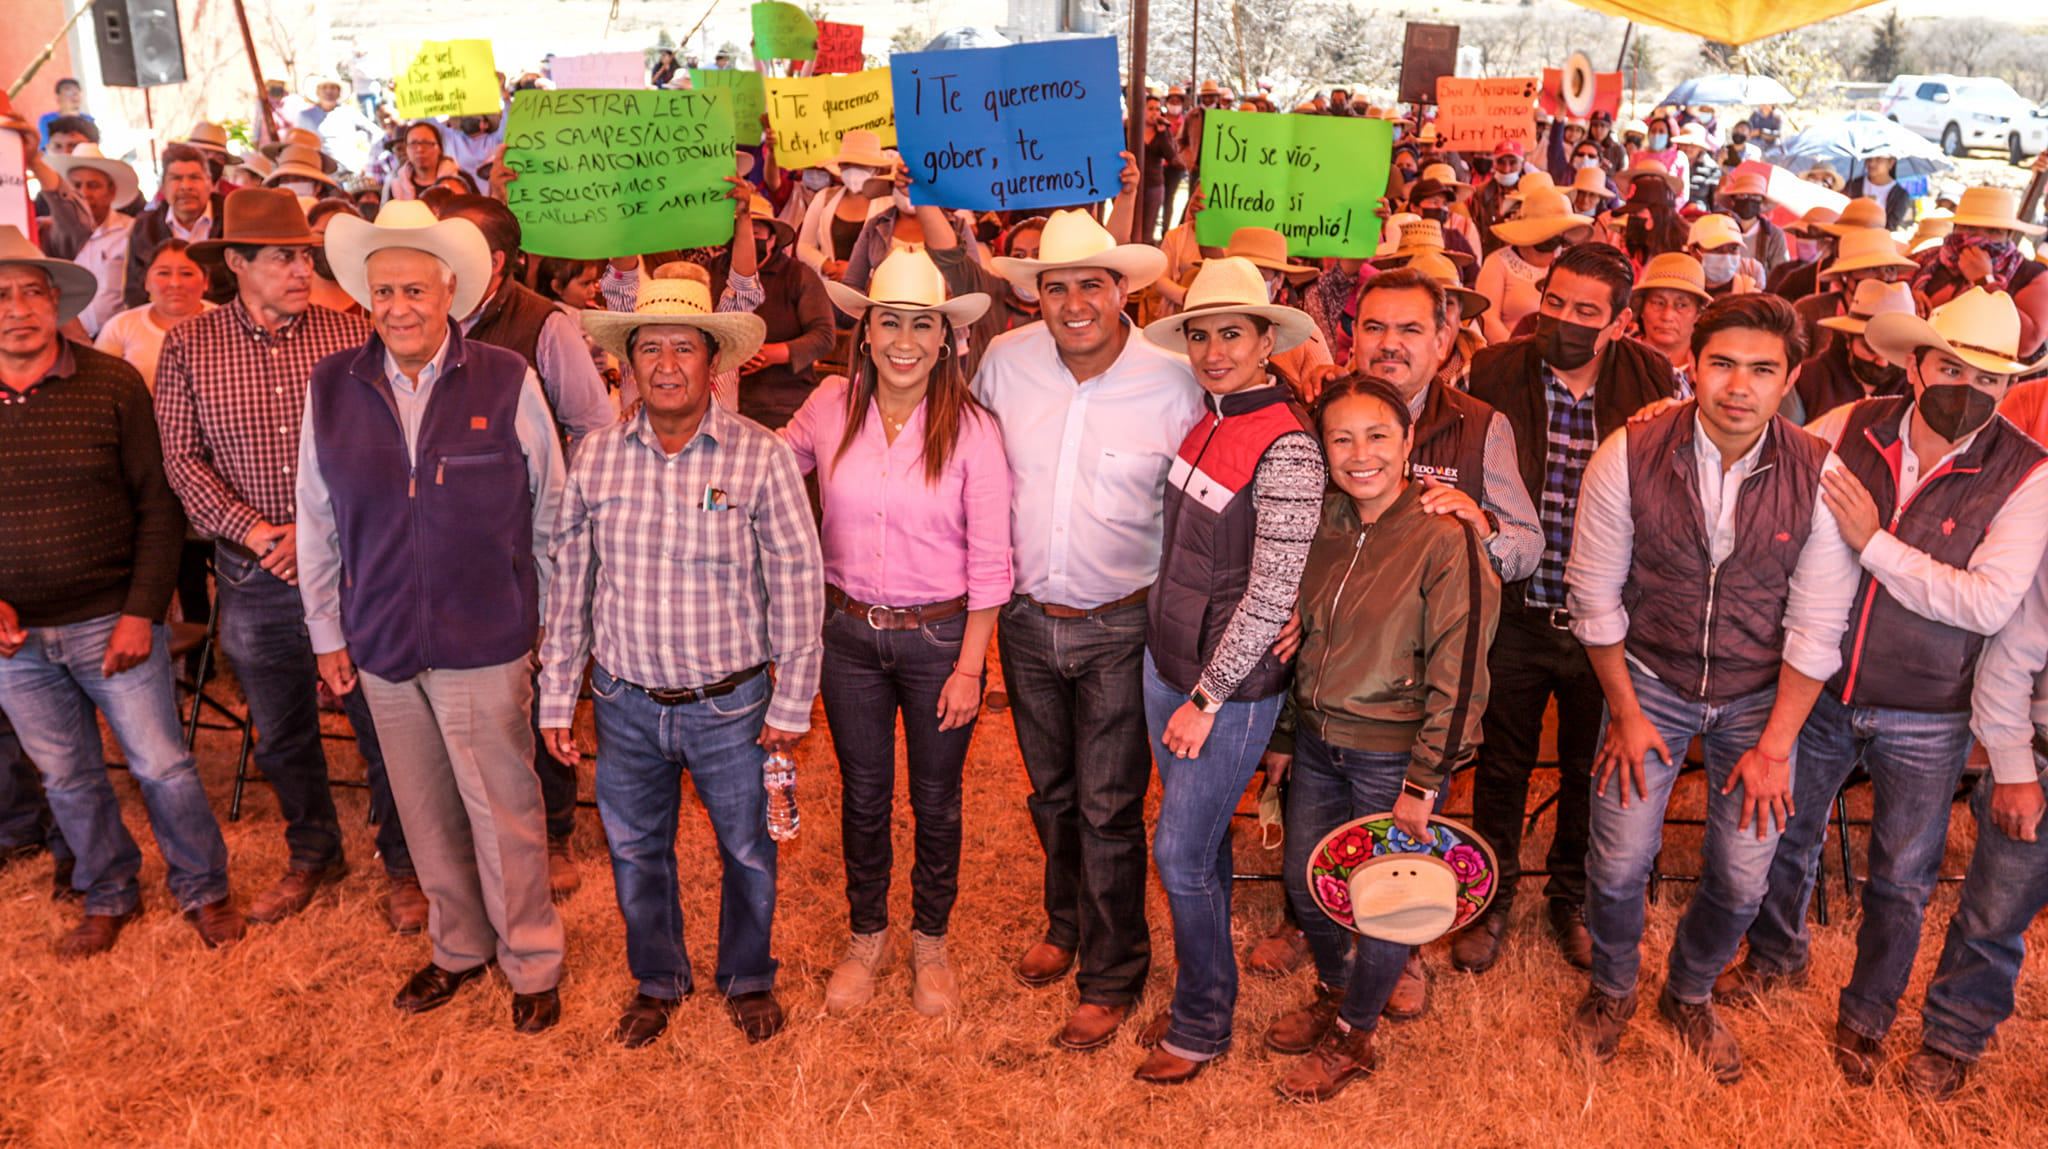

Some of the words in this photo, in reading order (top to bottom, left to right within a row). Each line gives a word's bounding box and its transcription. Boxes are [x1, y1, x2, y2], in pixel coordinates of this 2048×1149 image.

[511, 92, 641, 120] MAESTRA
[653, 93, 717, 120] LETY
[771, 90, 809, 119] ¡Te
[822, 89, 880, 119] queremos
[910, 68, 963, 116] ¡Te
[984, 79, 1087, 122] queremos
[507, 159, 537, 174] DE
[577, 150, 671, 173] ANTONIO
[923, 141, 999, 184] gober,
[1015, 128, 1044, 161] te
[1259, 147, 1278, 165] se
[508, 187, 534, 205] LE
[990, 156, 1100, 207] queremos!
[617, 201, 650, 219] DE
[1208, 182, 1276, 213] Alfredo
